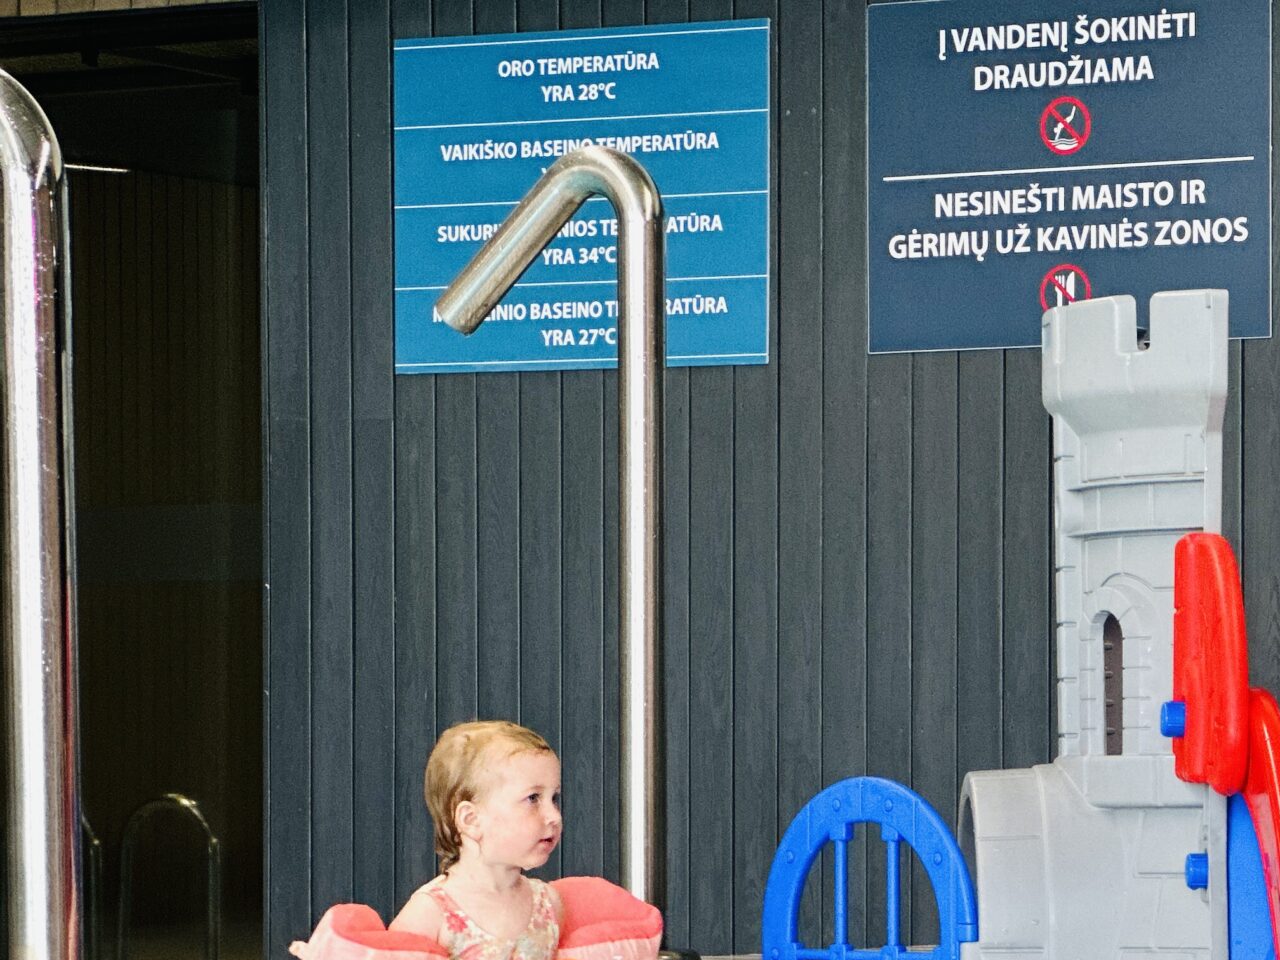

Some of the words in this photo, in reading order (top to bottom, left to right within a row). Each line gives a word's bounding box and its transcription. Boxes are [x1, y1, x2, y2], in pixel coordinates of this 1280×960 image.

[938, 29, 947, 61] Į
[950, 21, 1068, 53] VANDENĮ
[1074, 8, 1196, 45] ŠOKINĖTI
[498, 59, 535, 78] ORO
[537, 50, 660, 75] TEMPERATŪRA
[974, 54, 1155, 91] DRAUDŽIAMA
[541, 84, 575, 102] YRA
[578, 82, 616, 101] 28°C
[440, 139, 518, 162] VAIKIŠKO
[934, 182, 1065, 218] NESINEŠTI
[1071, 180, 1174, 211] MAISTO
[1180, 179, 1207, 205] IR
[888, 228, 989, 262] GĖRIMŲ
[995, 223, 1031, 254] UŽ
[1037, 217, 1149, 252] KAVINĖS
[1153, 216, 1249, 246] ZONOS
[541, 246, 576, 266] YRA
[530, 300, 603, 320] BASEINO
[541, 329, 575, 346] YRA
